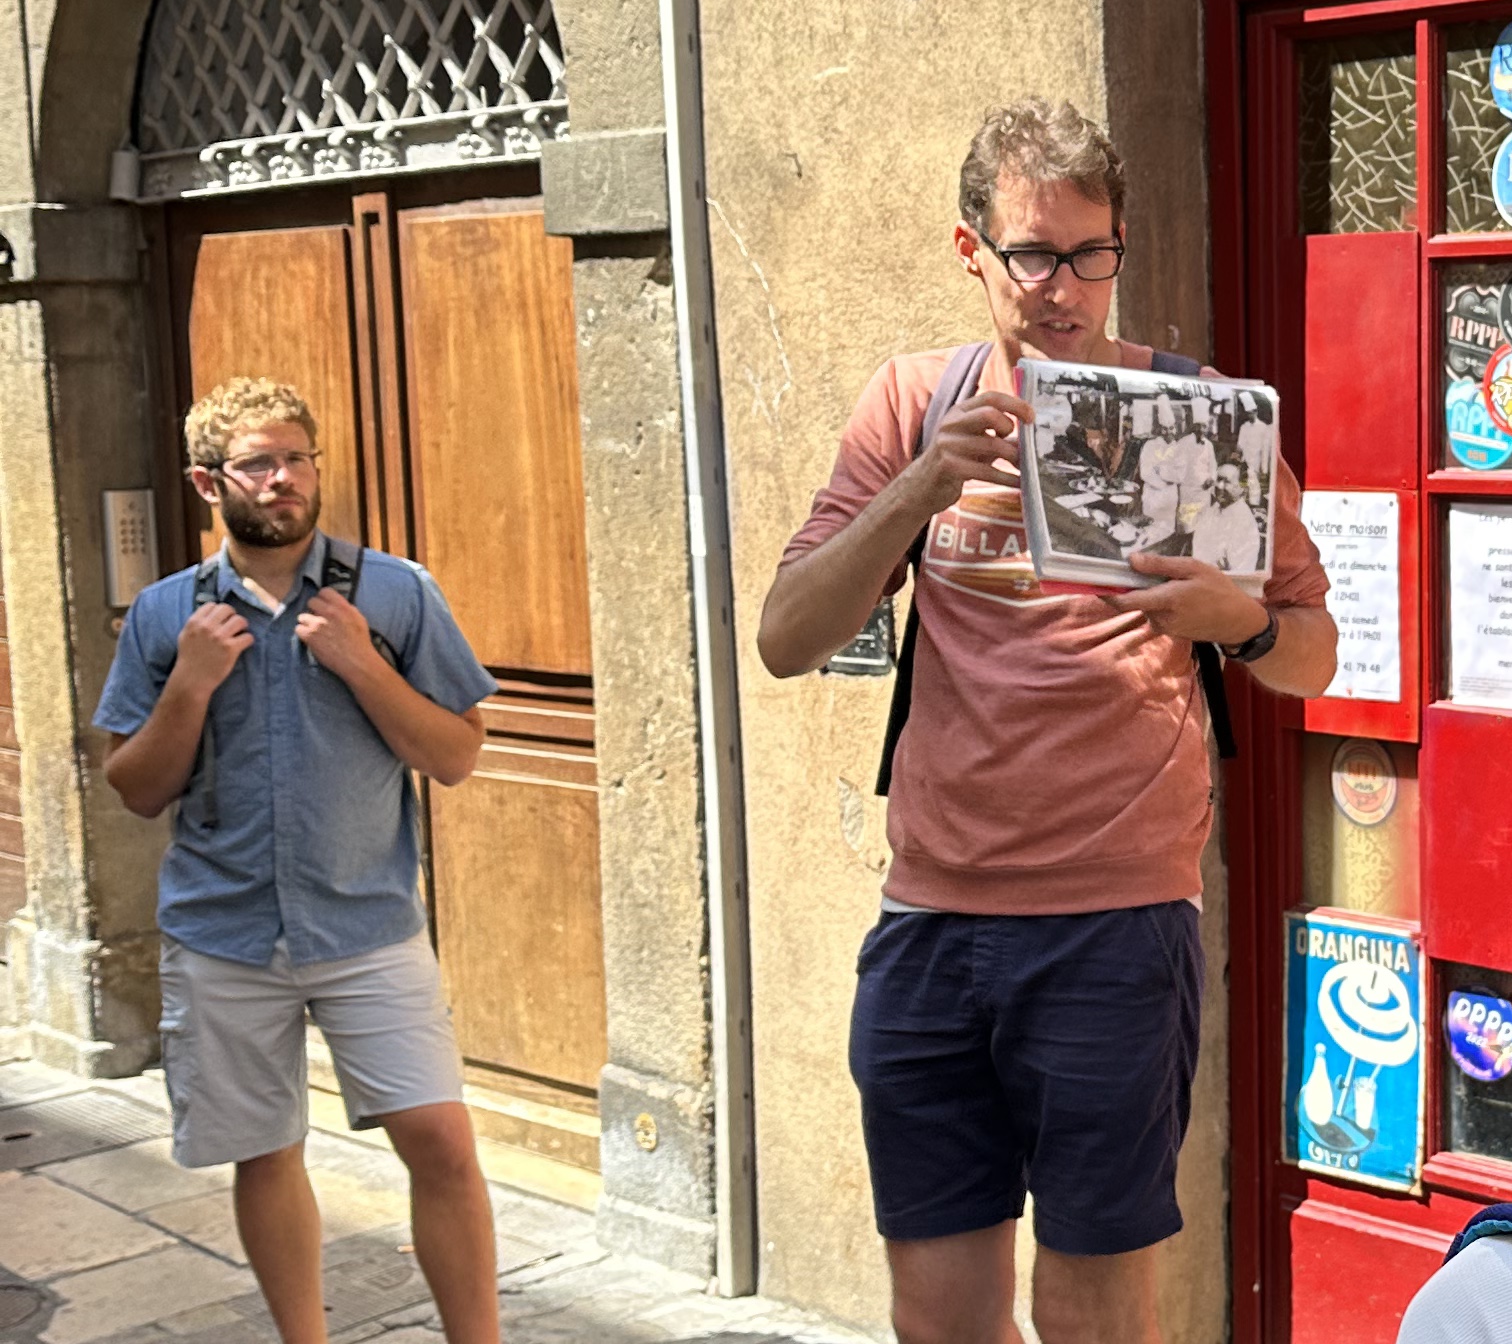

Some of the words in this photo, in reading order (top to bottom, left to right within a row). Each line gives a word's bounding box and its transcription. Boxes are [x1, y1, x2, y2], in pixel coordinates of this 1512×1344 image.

[1310, 520, 1343, 534] Notre
[1349, 523, 1388, 535] maison
[1495, 563, 1512, 572] sont
[1296, 926, 1411, 973] ORANGINA
